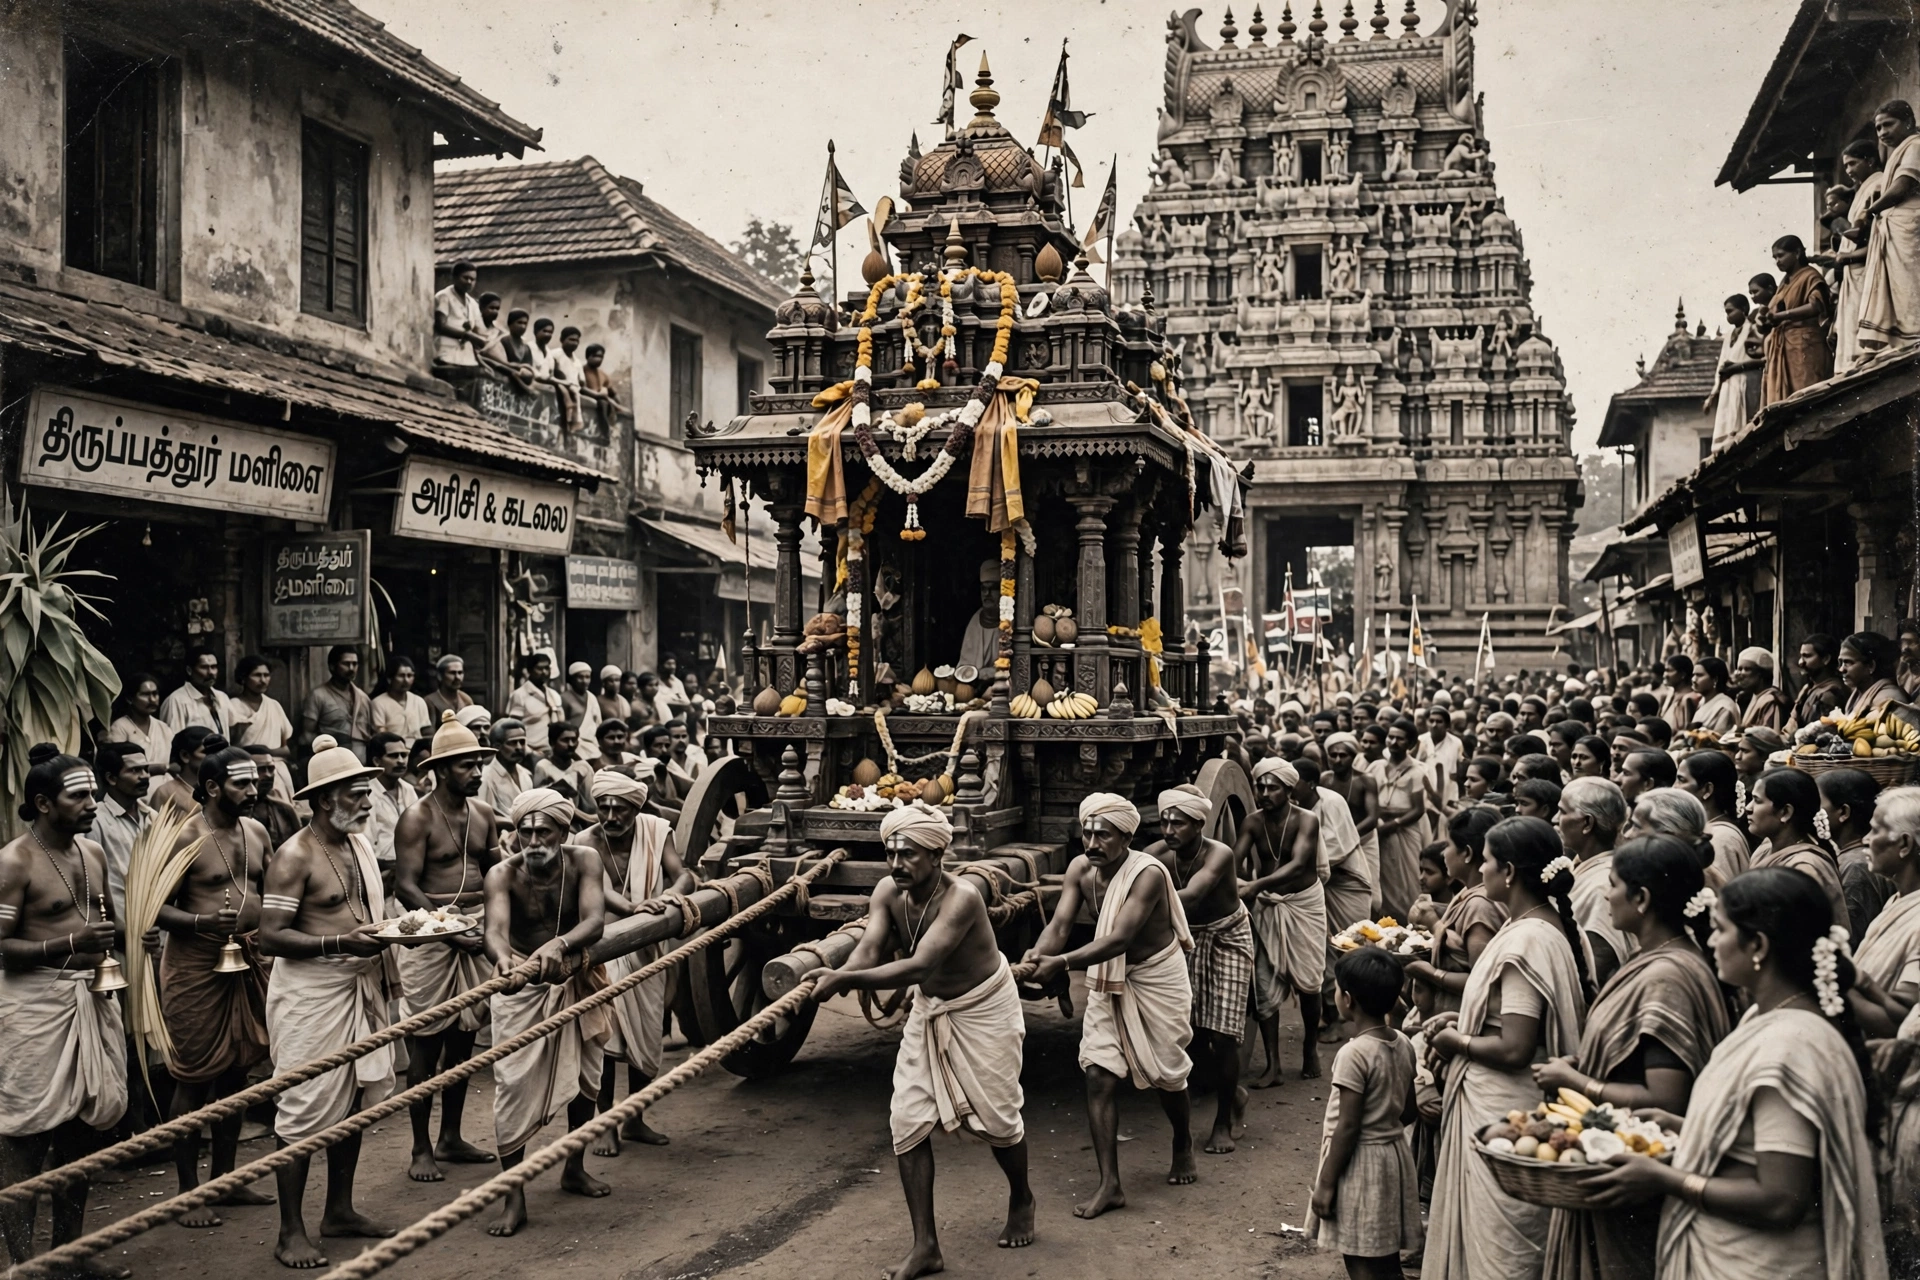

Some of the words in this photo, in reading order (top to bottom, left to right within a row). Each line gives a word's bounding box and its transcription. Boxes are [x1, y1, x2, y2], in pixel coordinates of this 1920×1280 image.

[411, 473, 481, 526] அரிசி
[483, 492, 497, 524] &
[502, 496, 568, 534] கடலை
